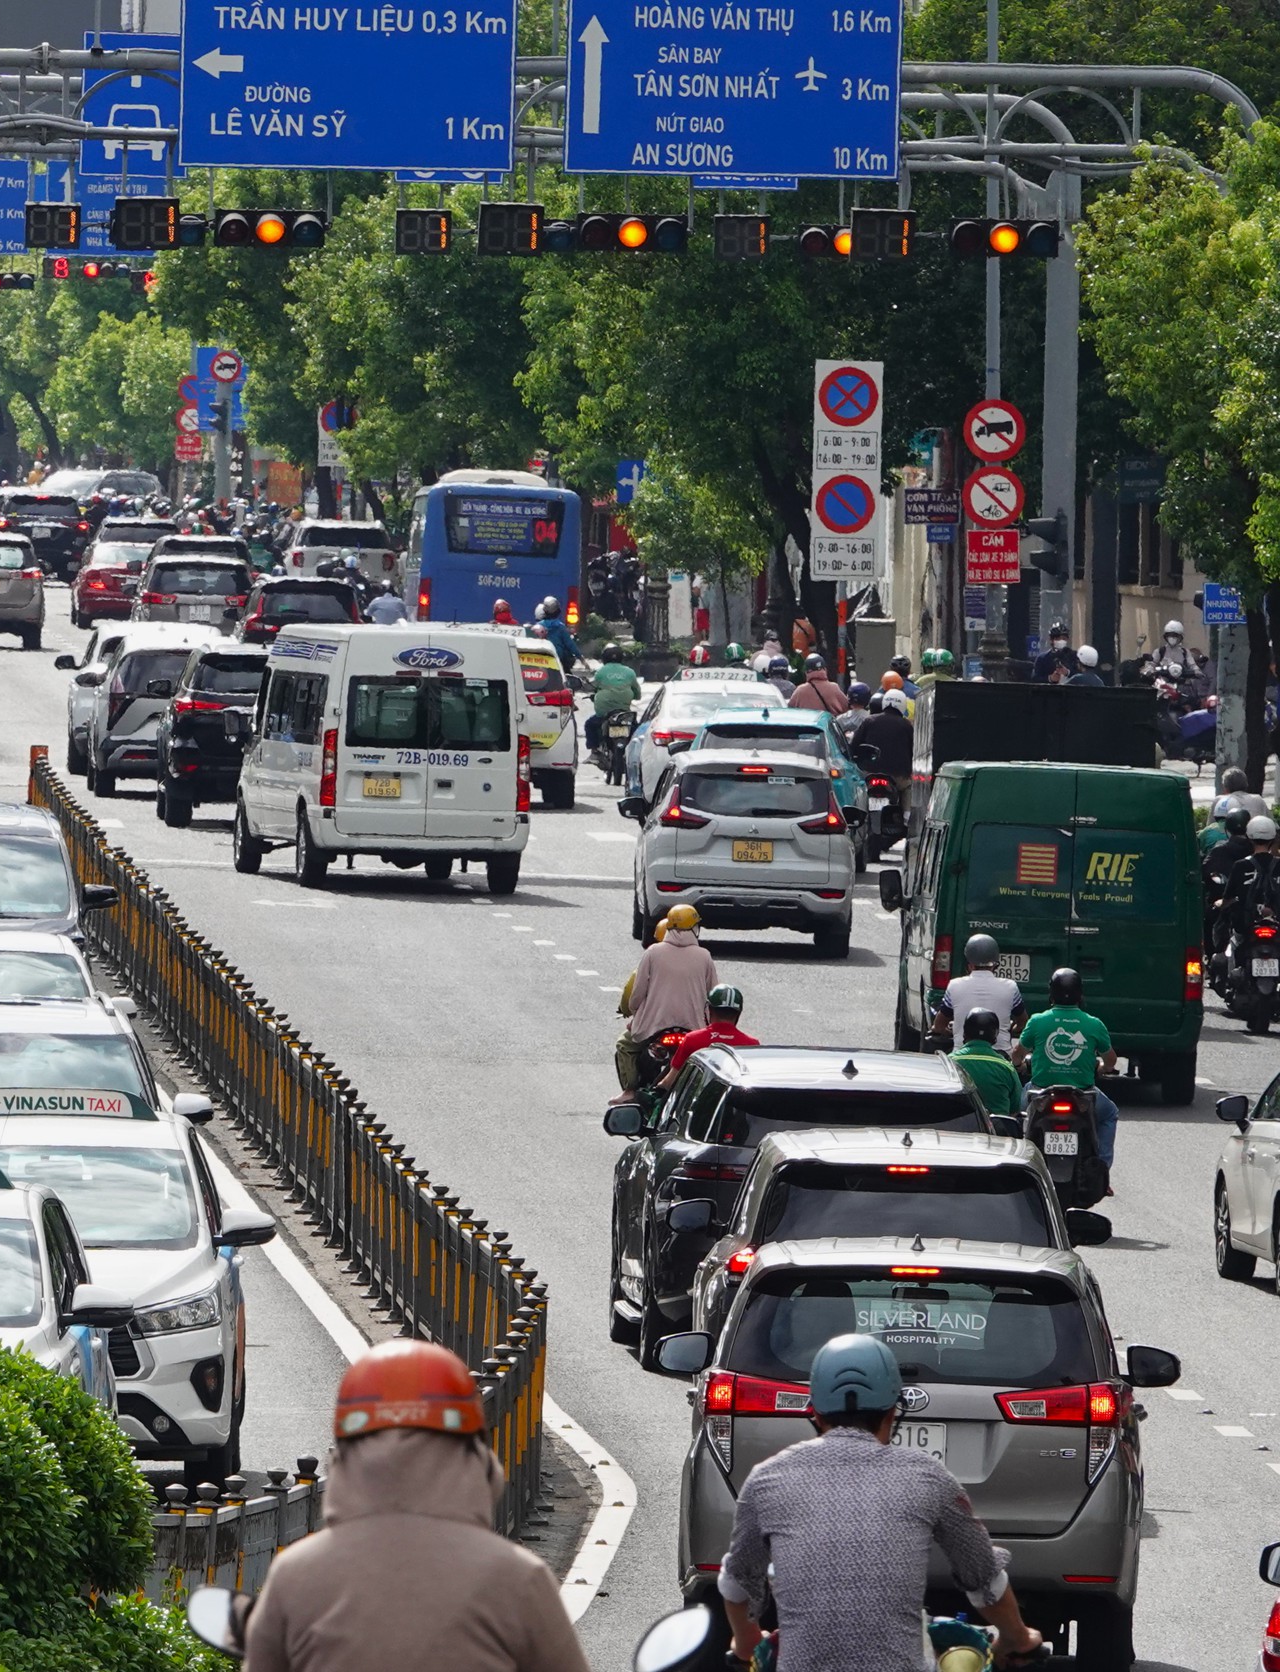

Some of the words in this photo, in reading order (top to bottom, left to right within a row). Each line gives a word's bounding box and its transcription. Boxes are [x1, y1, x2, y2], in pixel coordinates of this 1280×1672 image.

[214, 0, 285, 30] TRẦN
[294, 8, 348, 31] HUY
[355, 4, 414, 37] LIỆU
[422, 10, 457, 35] 0,3
[465, 11, 507, 35] Km
[634, 1, 705, 29] HOÀNG
[711, 2, 750, 31] VĂN
[755, 8, 794, 37] THỤ
[832, 10, 854, 33] 1,6
[860, 10, 892, 33] Km
[658, 44, 690, 63] SÂN
[693, 47, 722, 64] BAY
[633, 70, 672, 97] TÂN
[678, 73, 719, 98] SƠN
[725, 67, 780, 99] NHẤT
[841, 79, 852, 100] 3
[858, 79, 890, 101] Km
[245, 82, 311, 103] ĐƯỜNG
[210, 107, 242, 136] LÊ
[250, 109, 304, 137] VĂN
[312, 109, 347, 138] SỸ
[445, 117, 454, 140] 1
[463, 117, 505, 140] Km
[656, 112, 686, 132] NÚT
[690, 116, 724, 133] GIAO
[632, 143, 660, 165] AN
[666, 141, 734, 167] SƯƠNG
[833, 147, 849, 169] 10
[856, 147, 888, 171] Km
[7, 178, 25, 189] Km
[0, 208, 4, 219] 1
[7, 209, 25, 219] Km
[6, 240, 24, 251] Km
[823, 436, 842, 447] 6:00
[852, 437, 870, 447] 9:00
[818, 453, 842, 464] 16:00
[852, 454, 875, 465] 19:00
[534, 520, 558, 543] 04
[982, 532, 1004, 546] CẤM
[409, 649, 448, 667] Ford
[396, 751, 469, 767] 72B-019.69
[368, 788, 397, 796] 019.69
[736, 851, 769, 860] 094.75
[999, 887, 1027, 897] Where
[1031, 888, 1070, 899] Everyone
[1079, 892, 1101, 901] Feels
[1105, 893, 1133, 903] Proud!
[968, 920, 1009, 929] TRANSIT
[1000, 955, 1020, 967] 51D
[3, 1095, 85, 1111] VINASUN
[87, 1097, 121, 1113] TAXI
[1046, 1144, 1076, 1153] 988.25
[857, 1310, 987, 1331] SILVERLAND
[886, 1334, 956, 1345] HOSPITALITY
[891, 1426, 928, 1448] 51G
